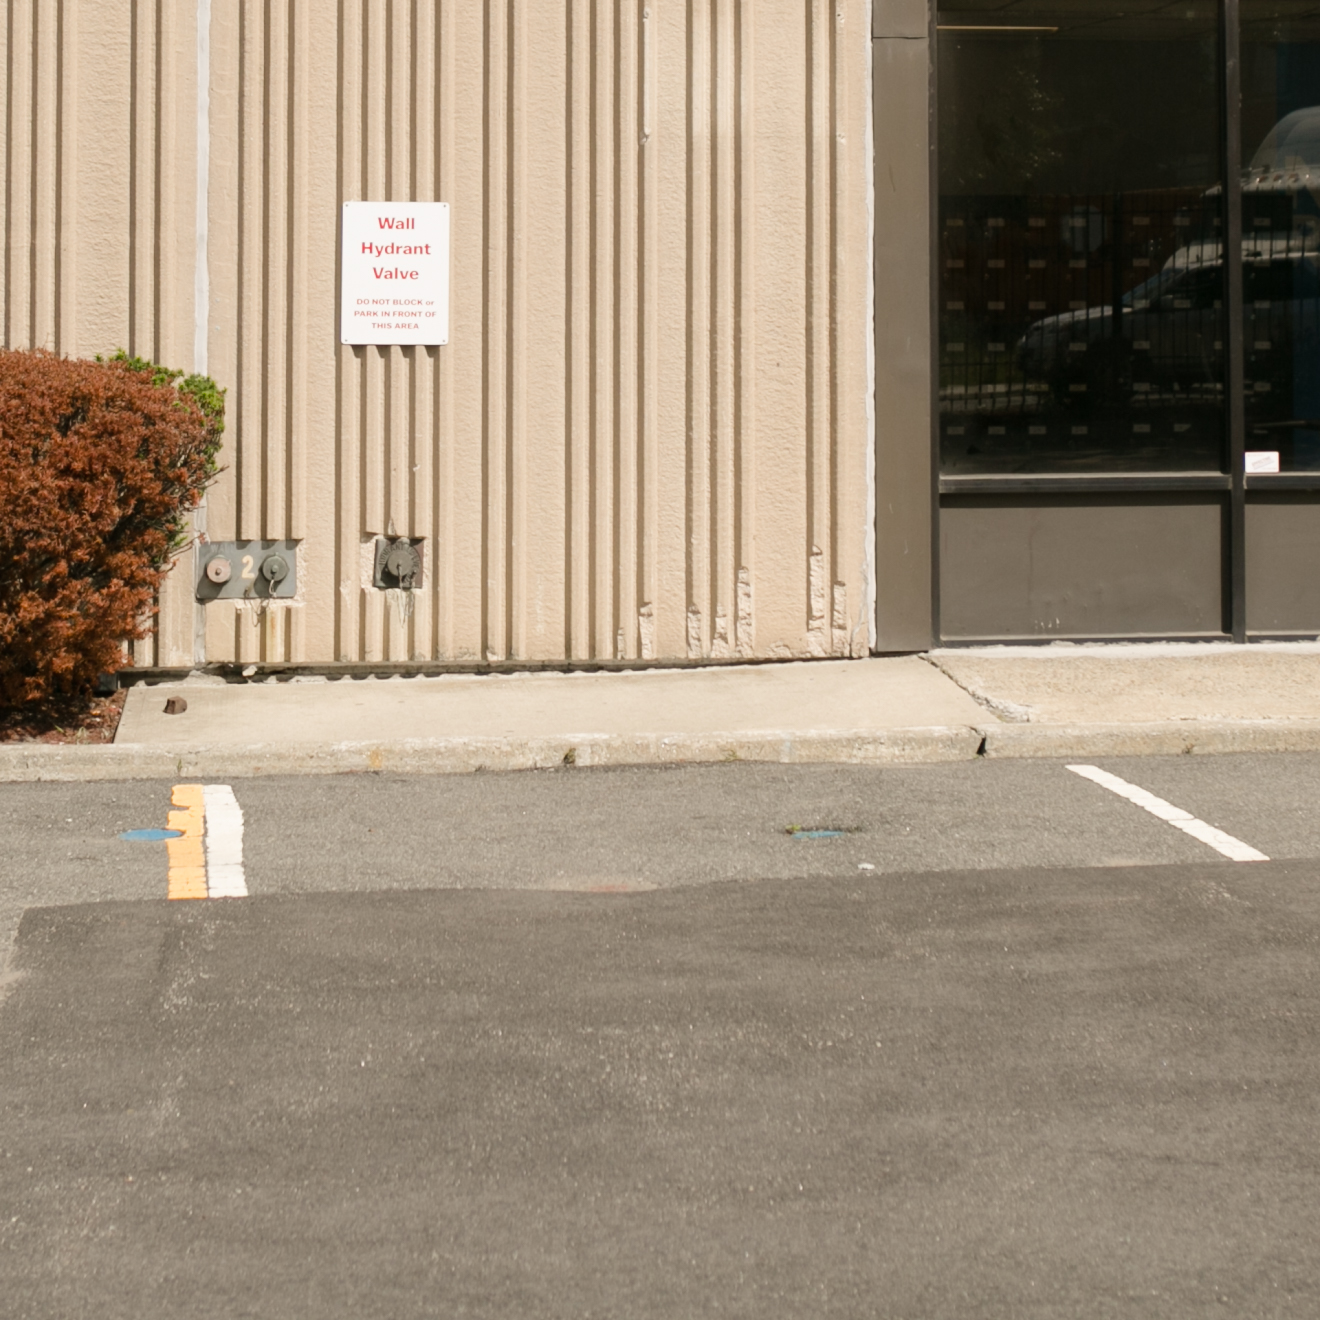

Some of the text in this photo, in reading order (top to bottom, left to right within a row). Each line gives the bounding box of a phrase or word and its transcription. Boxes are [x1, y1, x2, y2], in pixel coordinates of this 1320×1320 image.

[378, 217, 415, 230] Wall
[361, 242, 431, 258] Hydrant
[373, 267, 419, 280] Valve
[241, 554, 256, 579] 2
